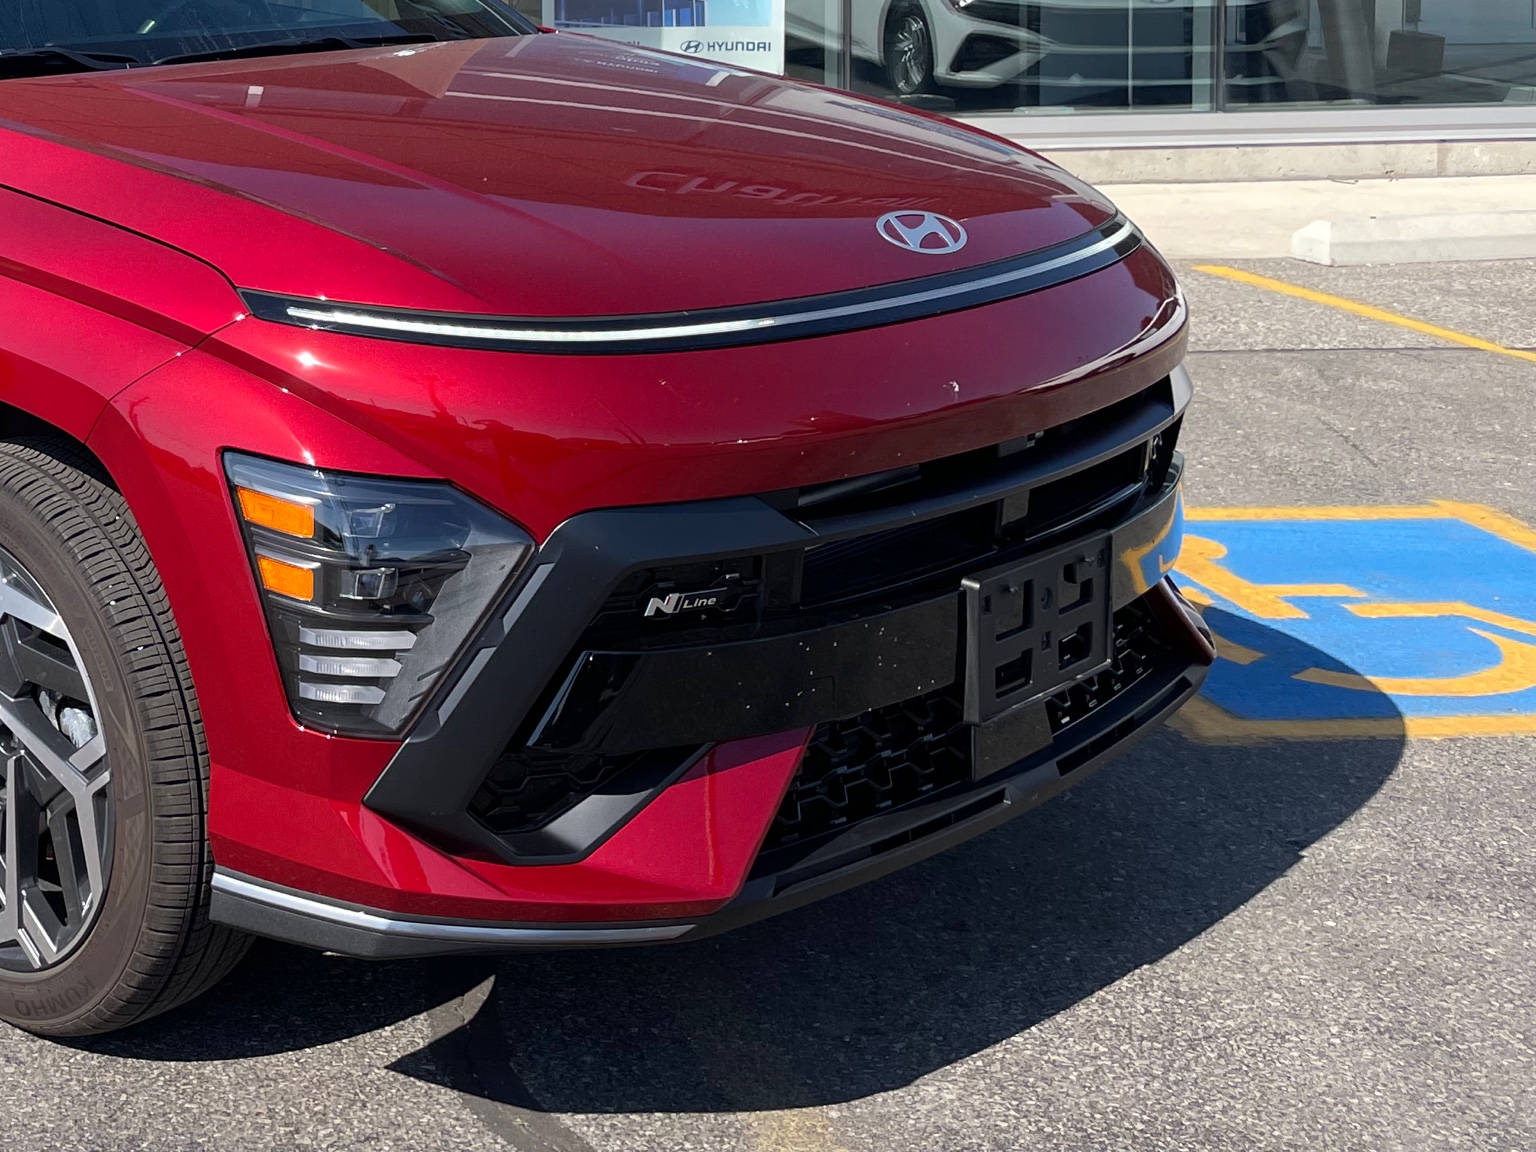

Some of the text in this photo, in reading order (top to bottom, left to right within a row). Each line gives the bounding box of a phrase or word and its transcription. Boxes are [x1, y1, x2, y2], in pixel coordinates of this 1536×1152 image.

[707, 41, 771, 52] HYUNDAI
[644, 593, 717, 617] N Line
[15, 975, 96, 1017] KUMHO
